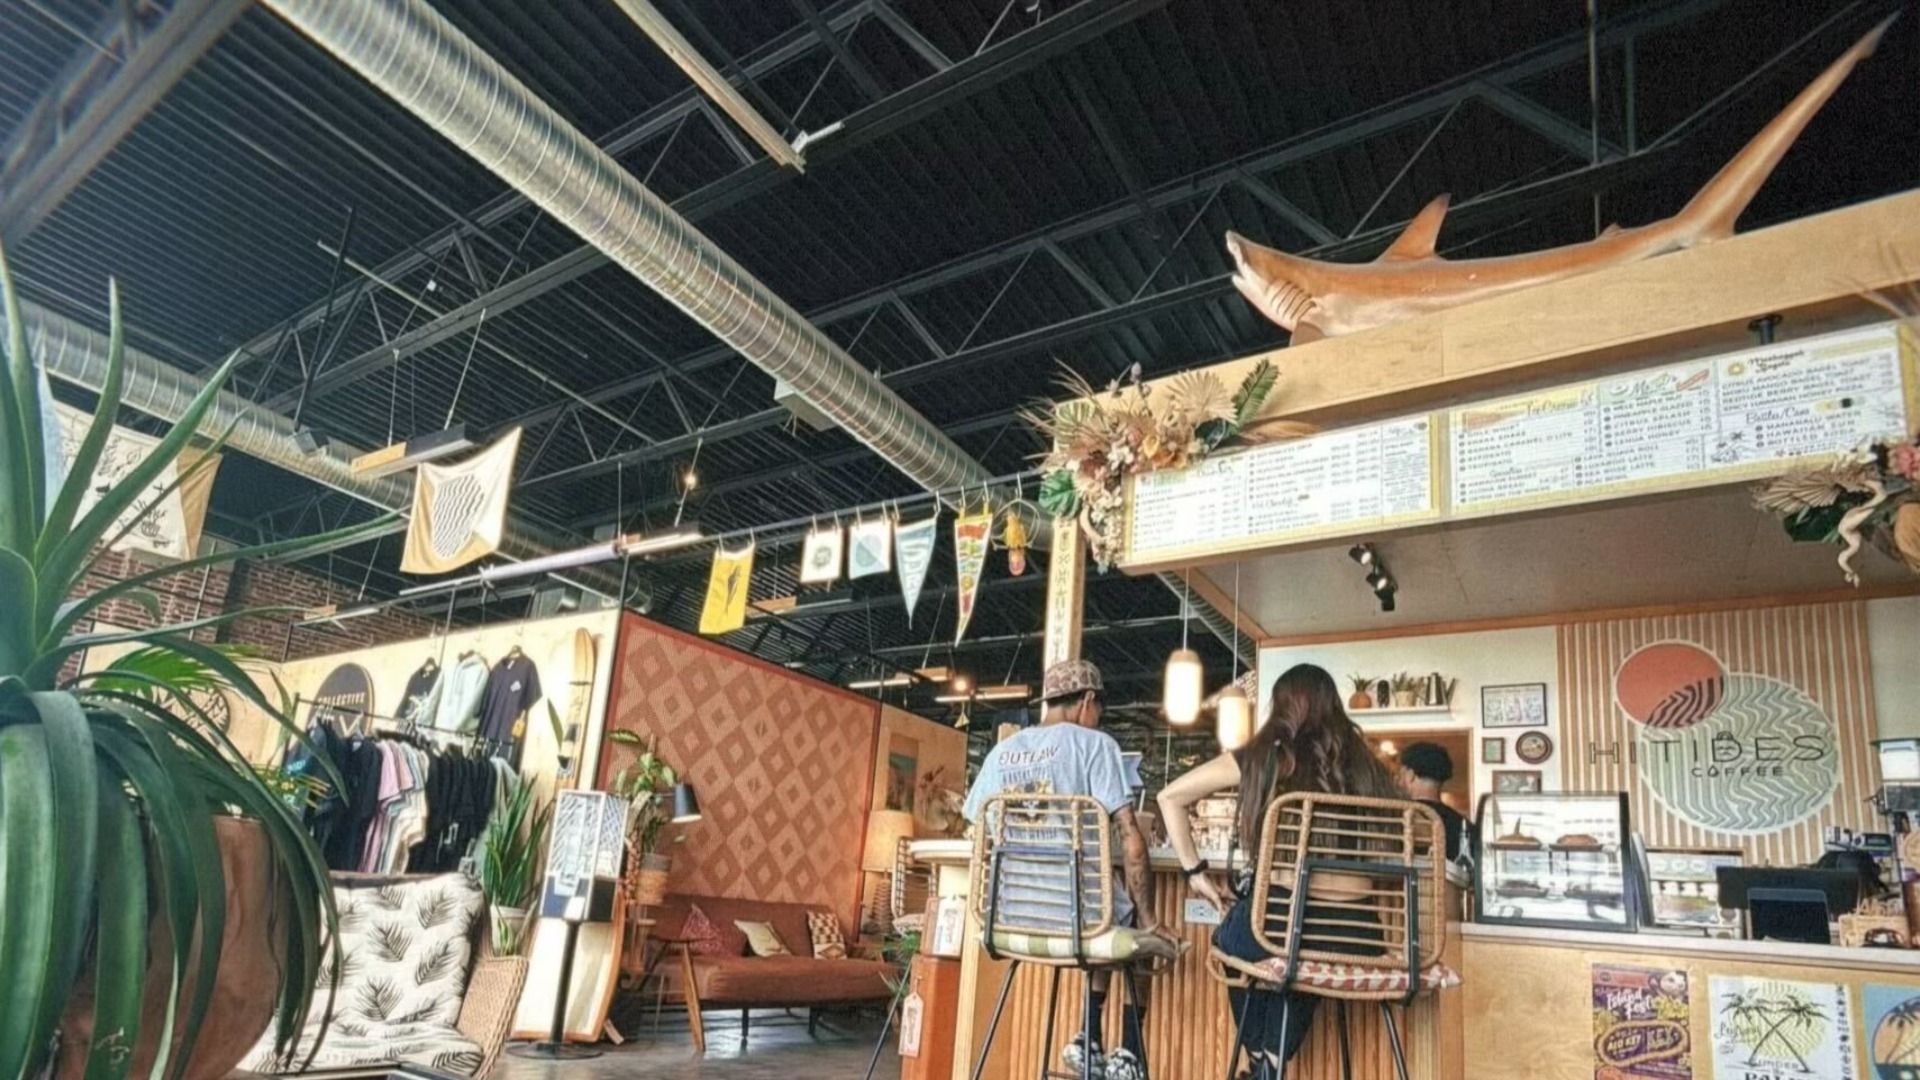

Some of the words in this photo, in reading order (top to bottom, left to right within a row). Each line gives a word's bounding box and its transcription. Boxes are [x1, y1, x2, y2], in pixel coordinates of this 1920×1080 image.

[1806, 363, 1837, 374] BAGEL
[1752, 380, 1788, 390] MANGO
[1790, 374, 1821, 384] BAGEL
[1766, 385, 1799, 396] BERRY
[1802, 380, 1834, 390] BAGEL
[1659, 401, 1693, 411] GLAZED
[1652, 411, 1690, 420] SPLASH
[1825, 409, 1861, 419] WATER
[1646, 419, 1691, 430] HIBISCUS
[1766, 423, 1825, 437] HAWAIIAN
[1830, 418, 1855, 427] SUN
[1767, 432, 1818, 446] BOTTLED
[1823, 426, 1856, 436] SODA
[318, 692, 365, 706] COLLECTIVE
[999, 745, 1059, 765] OUTLAW
[1691, 765, 1784, 778] COFFEE
